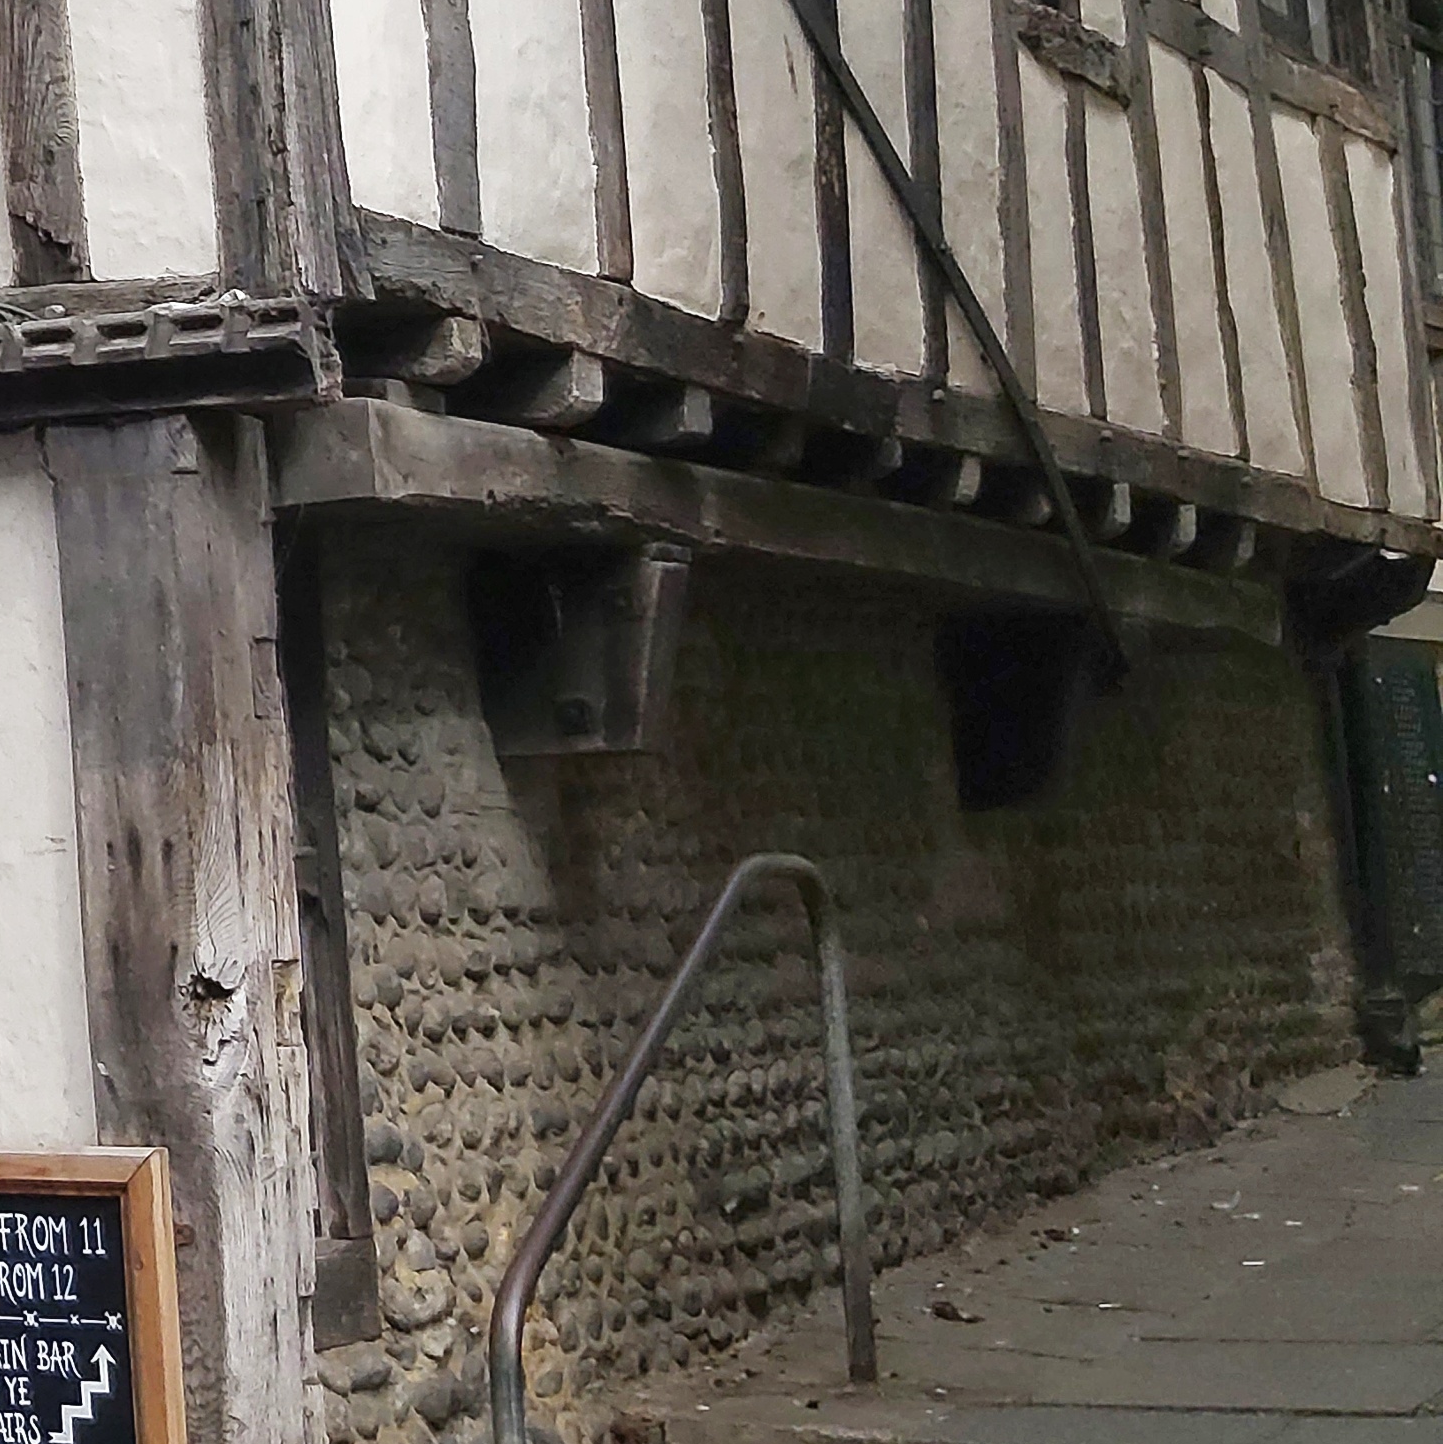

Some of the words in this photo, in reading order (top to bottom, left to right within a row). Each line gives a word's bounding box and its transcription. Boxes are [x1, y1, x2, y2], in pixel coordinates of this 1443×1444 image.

[79, 1216, 107, 1255] 11
[51, 1263, 78, 1301] 12
[36, 1340, 82, 1379] BAR
[3, 1375, 32, 1406] YE
